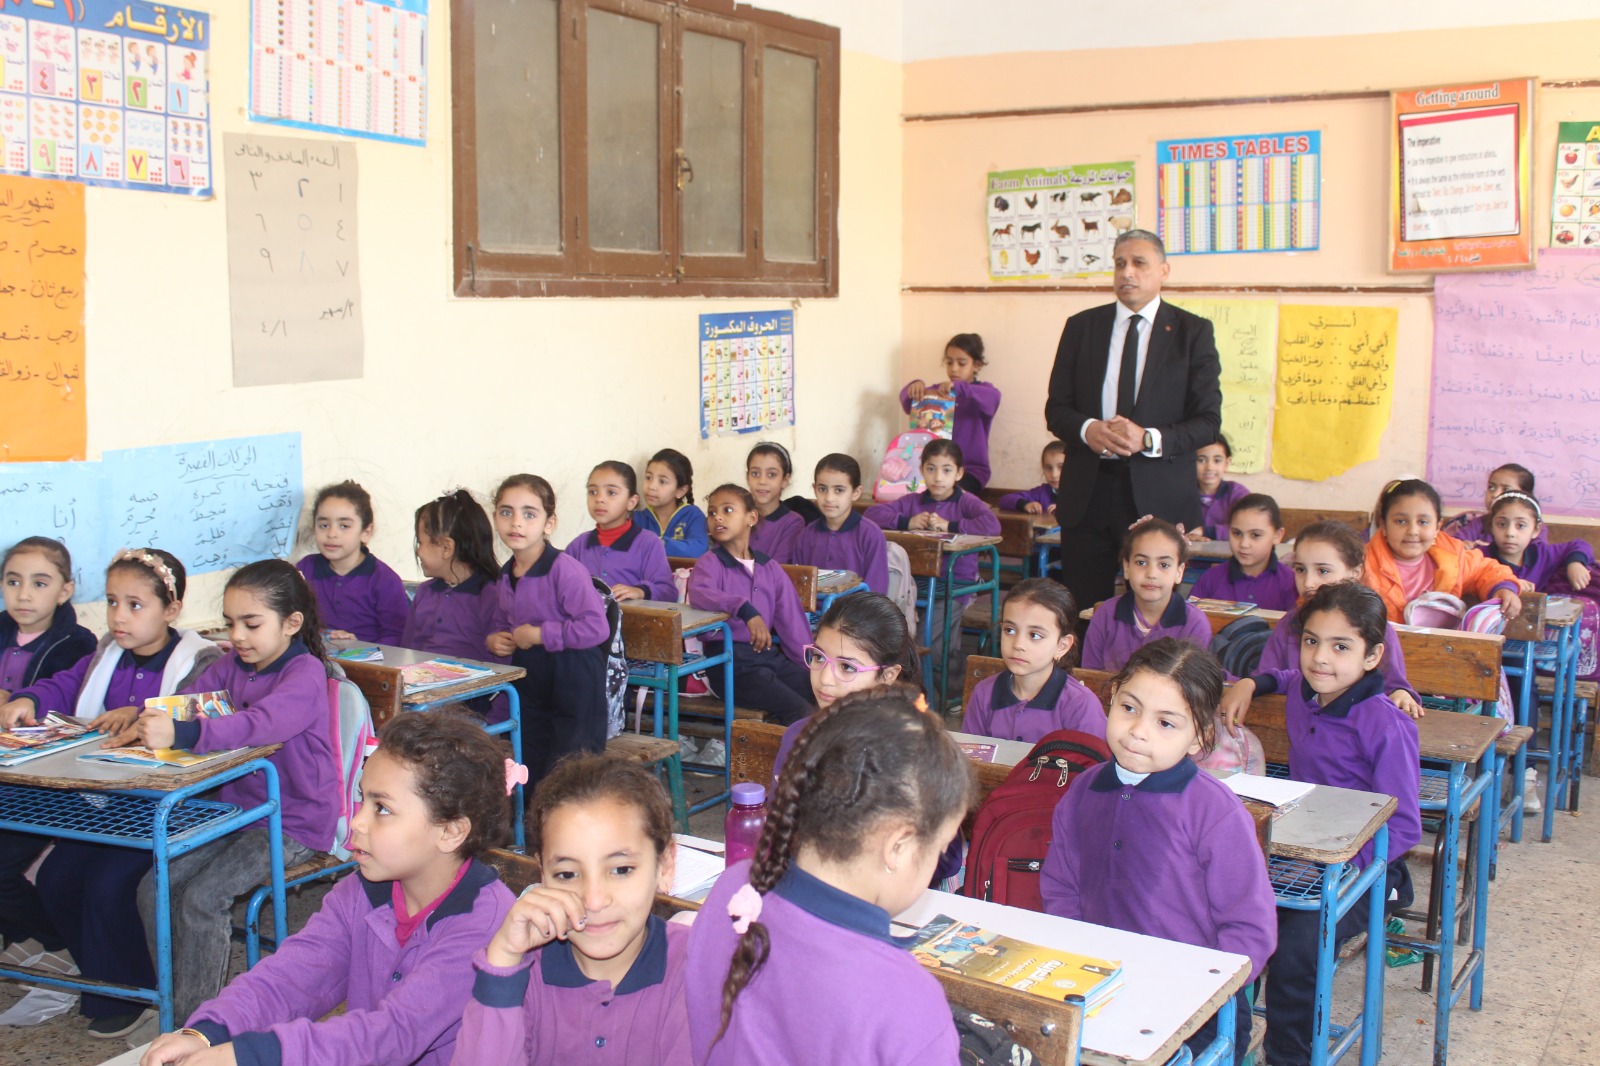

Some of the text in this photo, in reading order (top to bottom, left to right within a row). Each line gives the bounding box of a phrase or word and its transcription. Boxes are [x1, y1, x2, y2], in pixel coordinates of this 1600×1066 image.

[104, 5, 204, 43] الأرقام
[40, 67, 49, 91] ٤
[86, 75, 98, 96] ٣
[132, 81, 142, 103] ٢
[176, 88, 183, 109] ١
[1416, 84, 1499, 106] Getting around
[39, 143, 51, 167] ٩
[1168, 137, 1310, 161] TIMES TABLES
[85, 151, 98, 172] ٨
[132, 154, 143, 175] ٧
[173, 159, 185, 180] ٦
[249, 170, 263, 191] ٣
[298, 178, 310, 198] ٢
[991, 174, 1067, 190] Farm Animals
[336, 219, 347, 241] ٤
[260, 248, 274, 273] ٩
[336, 260, 349, 277] ٧
[705, 316, 778, 338] الحروف المكسورة
